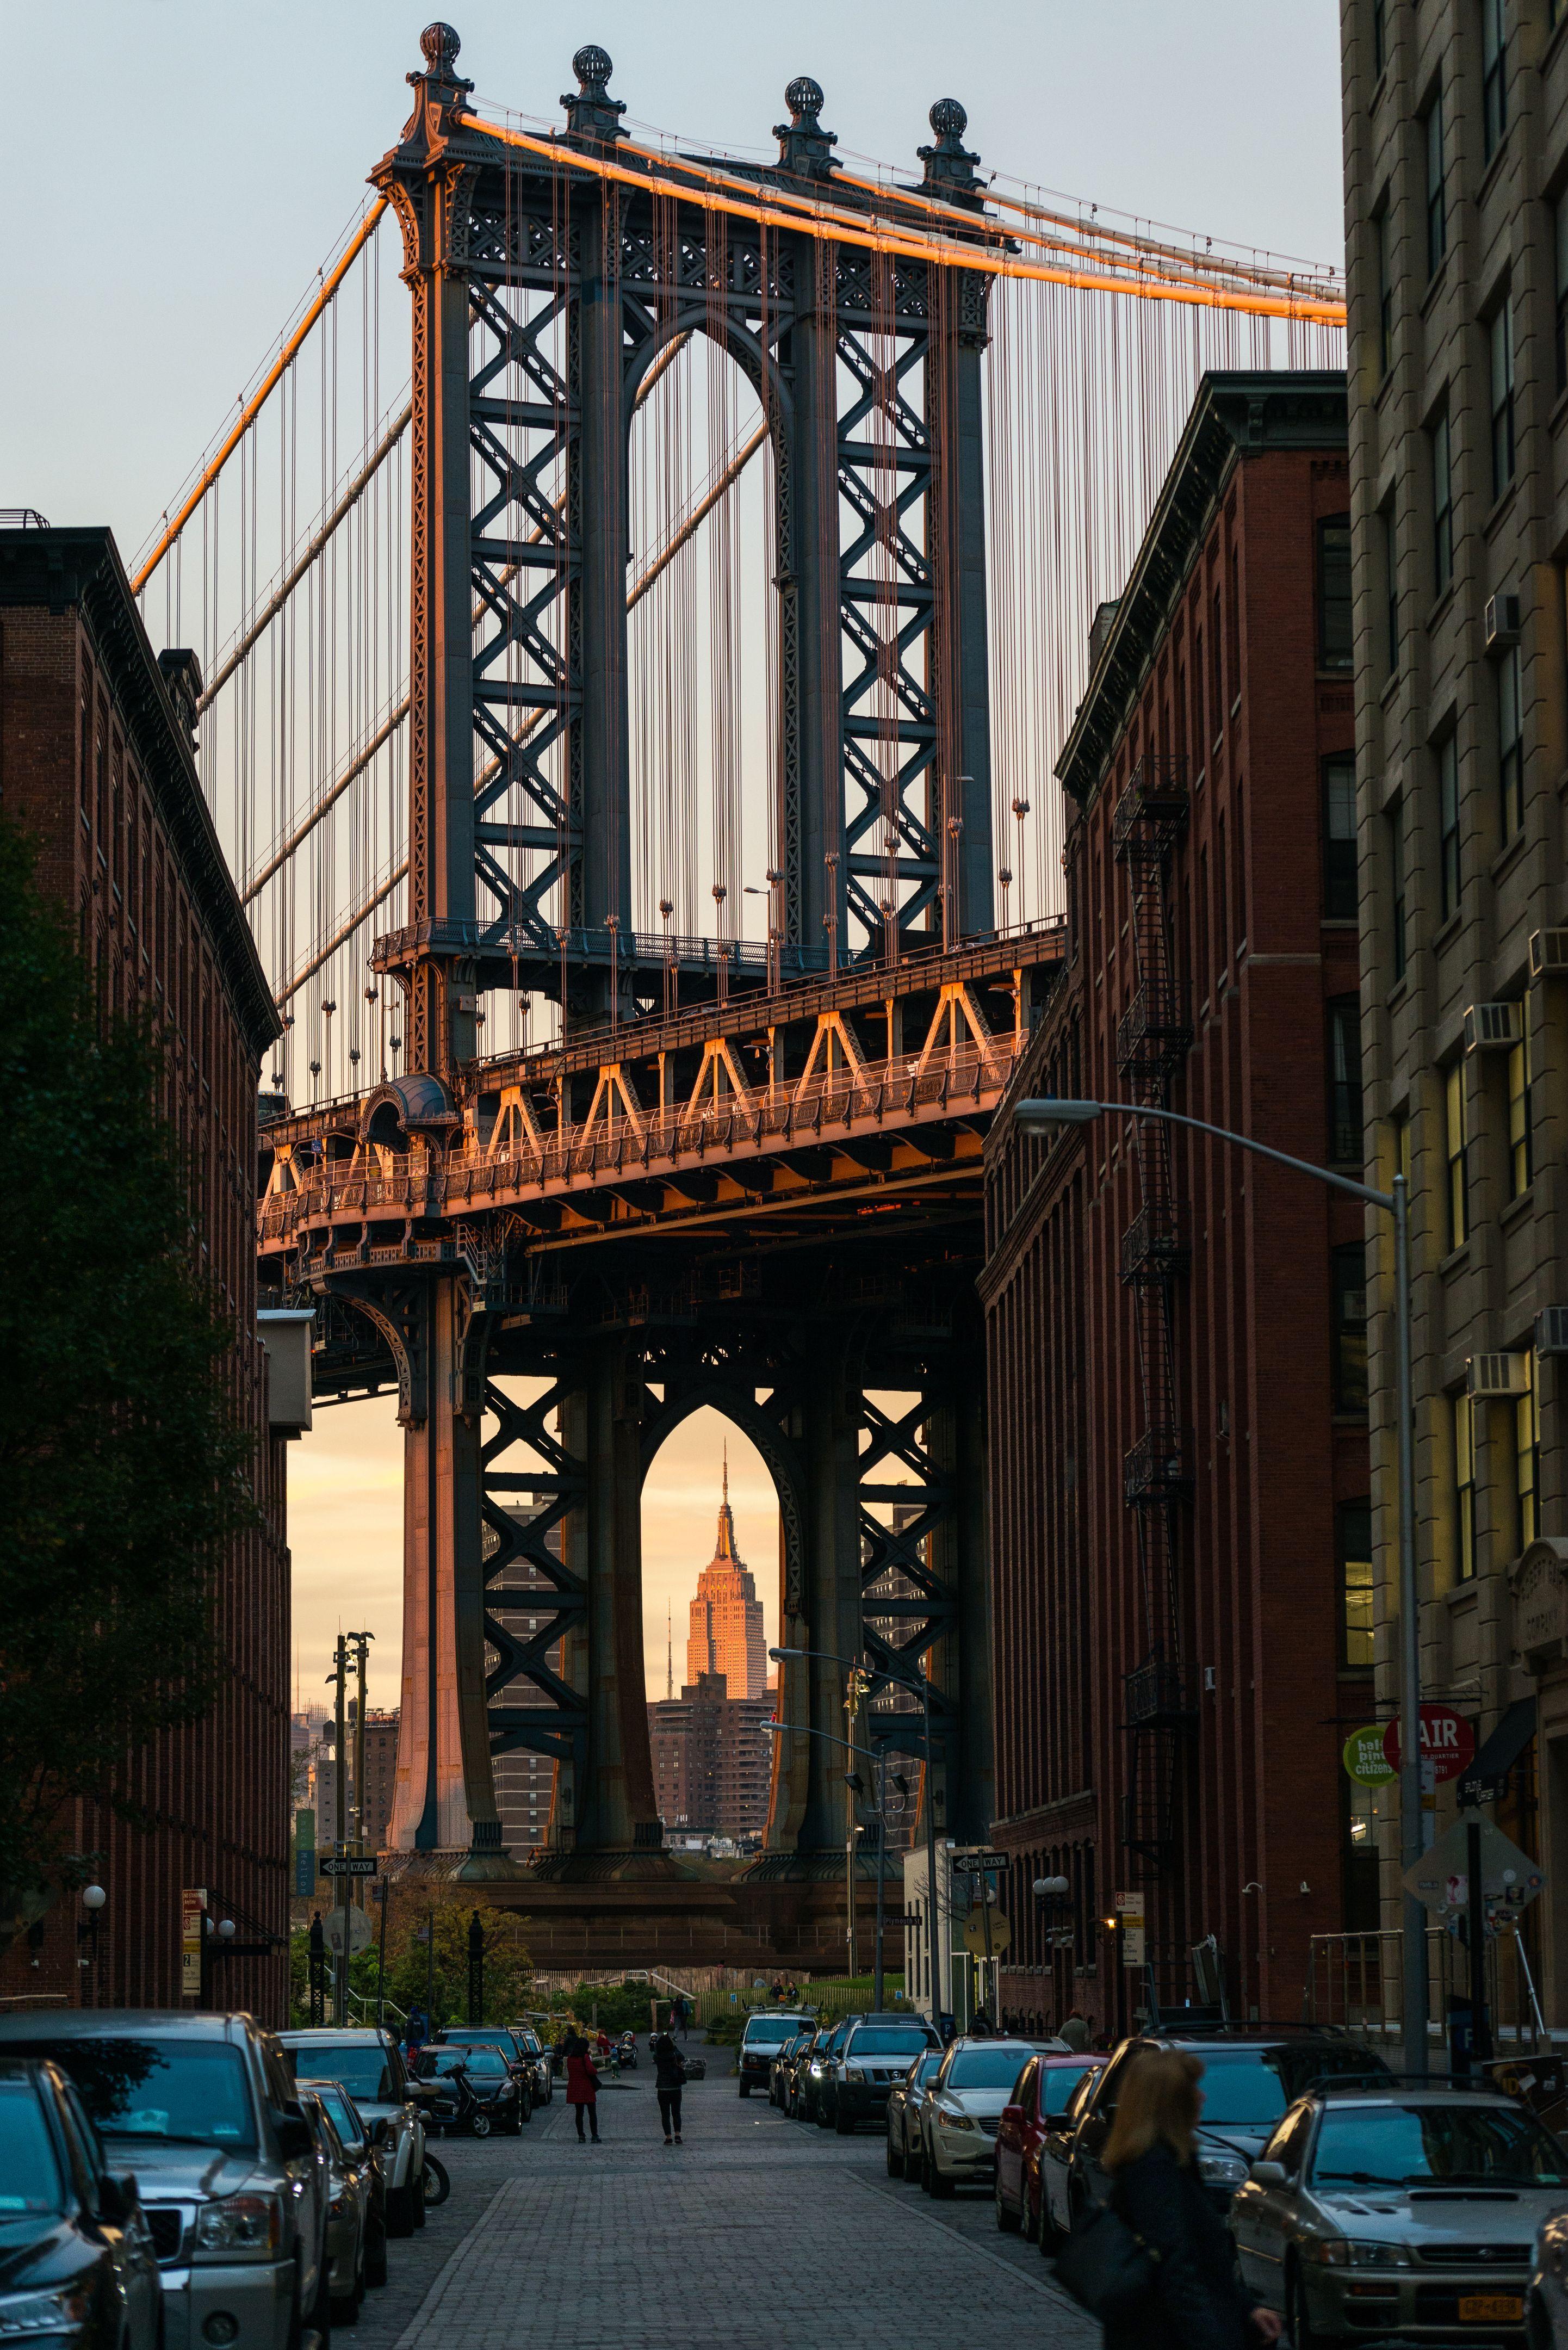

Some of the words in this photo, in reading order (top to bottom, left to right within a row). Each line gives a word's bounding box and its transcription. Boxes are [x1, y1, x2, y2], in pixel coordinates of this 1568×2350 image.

[1397, 1719, 1459, 1748] AIR
[1358, 1739, 1383, 1751] hal
[1356, 1762, 1392, 1774] citizens
[985, 1857, 1002, 1866] WAY
[885, 1916, 913, 1925] Plymouth
[184, 1955, 189, 1966] 2
[945, 2024, 951, 2032] P
